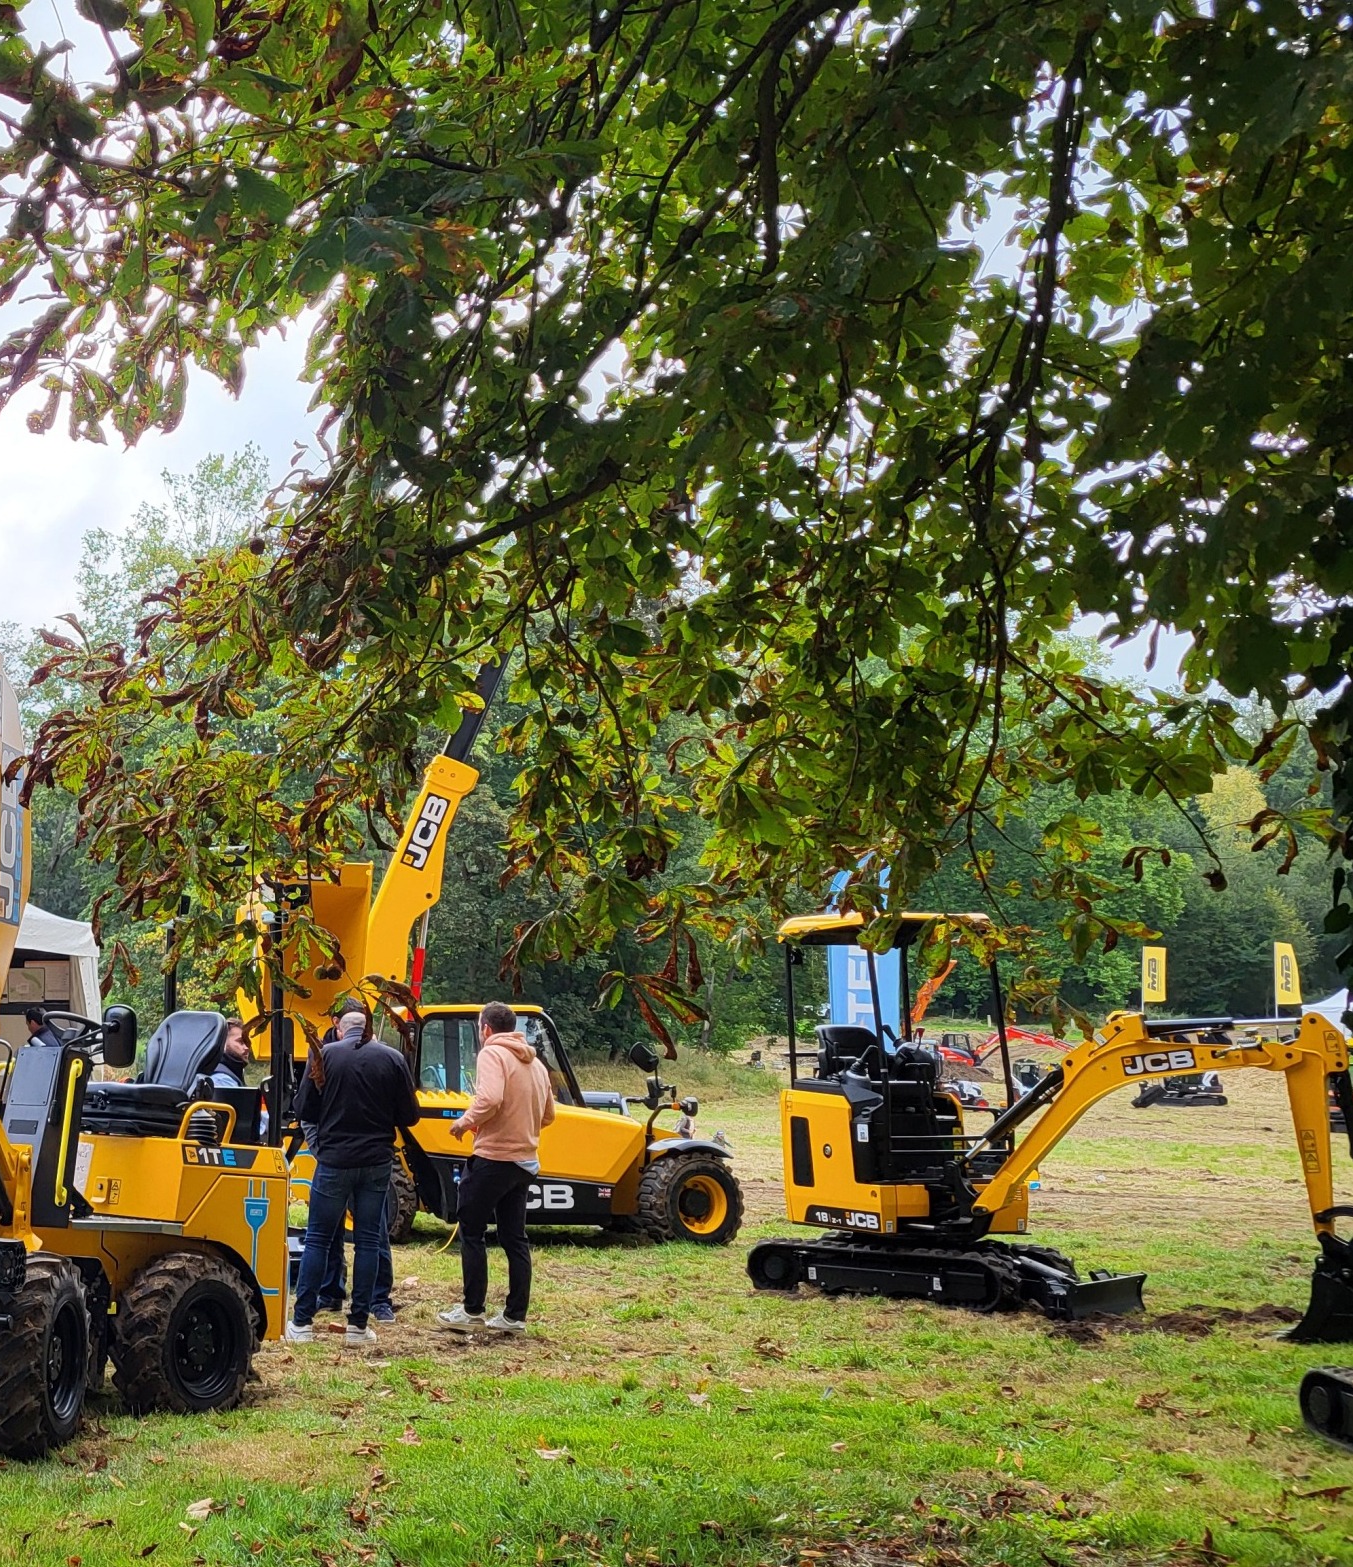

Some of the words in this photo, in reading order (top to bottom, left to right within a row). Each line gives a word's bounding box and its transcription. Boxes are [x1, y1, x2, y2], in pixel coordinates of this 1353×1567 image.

[408, 795, 447, 868] JCB
[1125, 1050, 1195, 1075] JCB
[198, 1147, 236, 1166] 1TE
[525, 1185, 575, 1209] CB
[816, 1211, 829, 1222] 18
[846, 1212, 879, 1229] JCB
